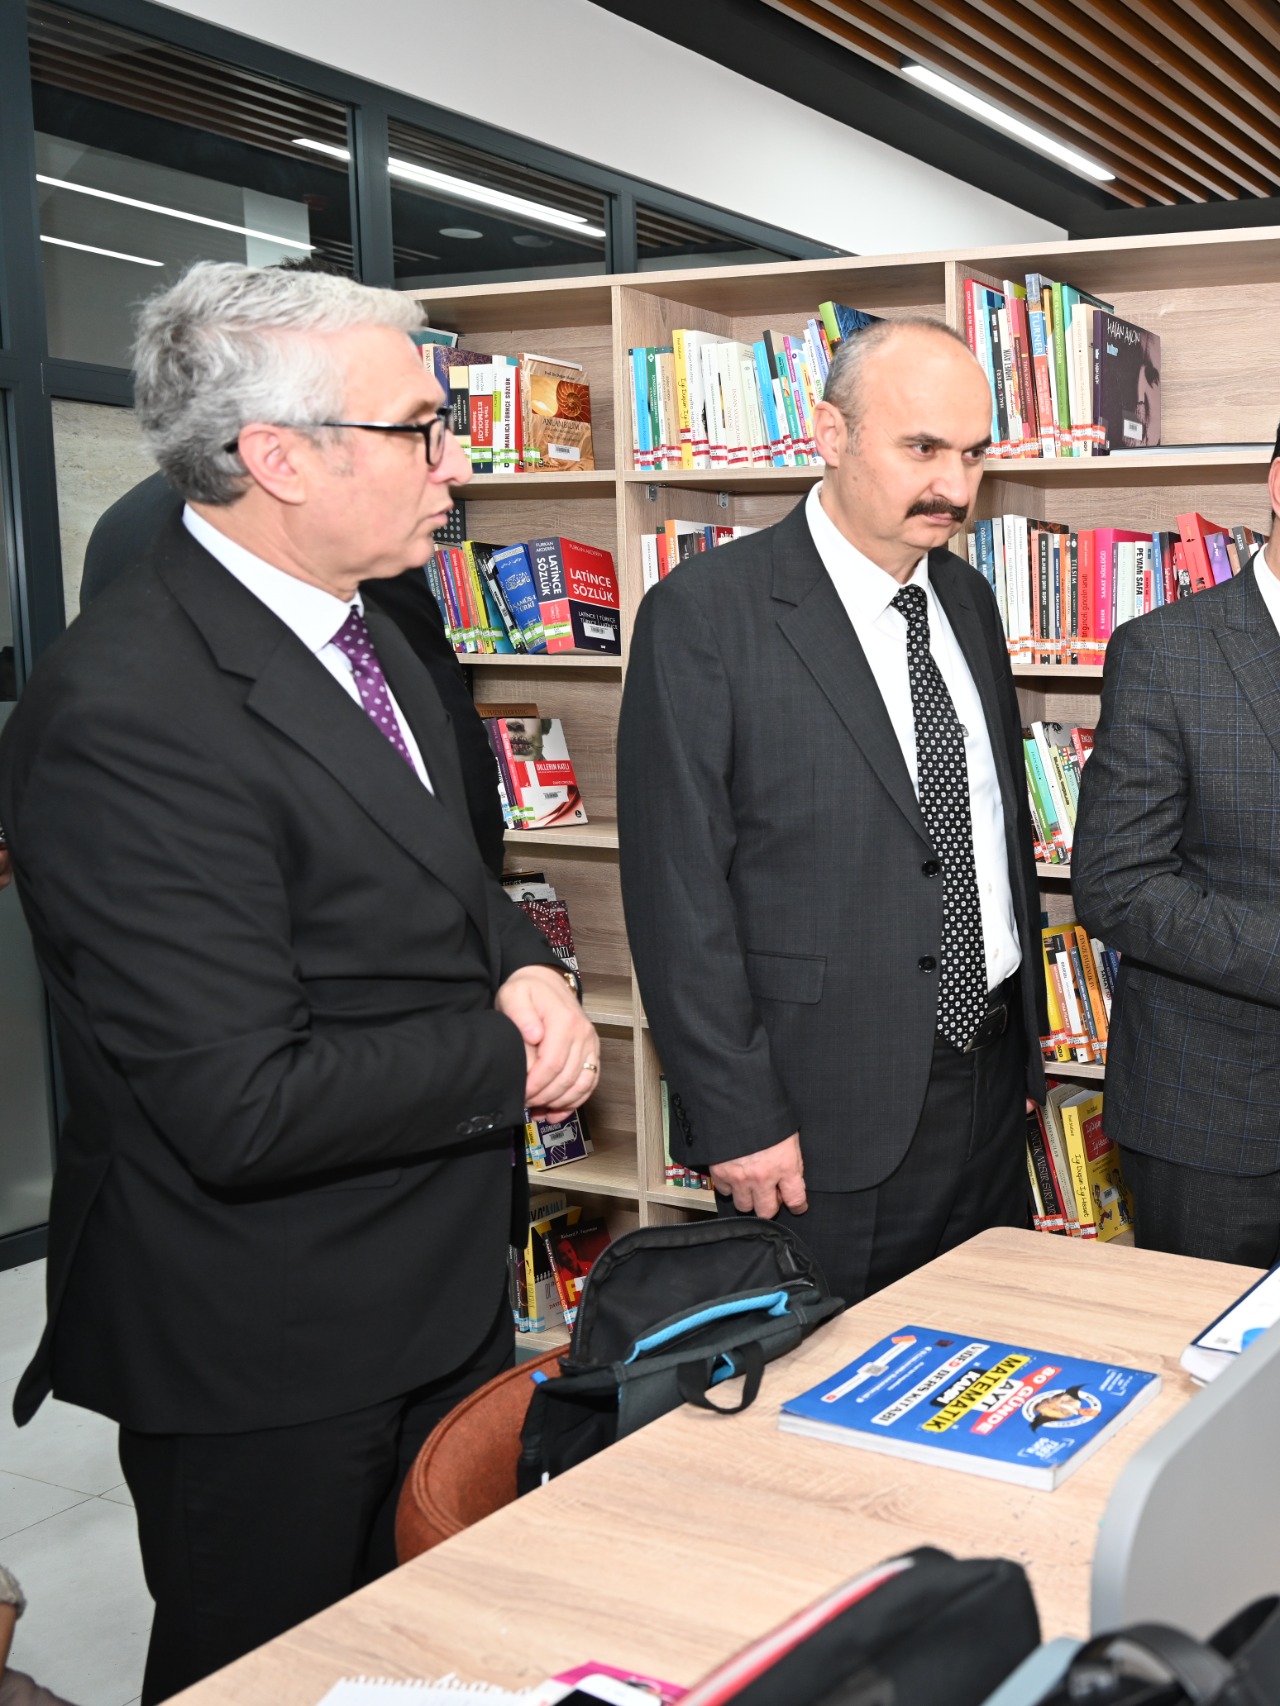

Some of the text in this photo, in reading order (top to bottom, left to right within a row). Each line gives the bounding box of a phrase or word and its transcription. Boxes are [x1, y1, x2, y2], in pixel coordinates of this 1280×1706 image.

[1032, 313, 1043, 355] TURNER
[536, 557, 551, 596] SÖZLÜK
[548, 555, 562, 594] LATİNCE
[570, 568, 612, 588] LATİNCE
[573, 583, 614, 602] SÖZLÜK
[579, 611, 596, 620] LATİNCE
[536, 763, 556, 771] DİLLERİN
[1079, 935, 1088, 954] CENAZE
[1030, 1128, 1040, 1155] ANTİK
[1037, 1155, 1048, 1182] MISIR
[1075, 1166, 1084, 1185] Düşün
[1082, 1197, 1090, 1217] Hisset
[914, 1368, 952, 1392] DERS
[924, 1355, 1021, 1430] MATEMATİK
[934, 1370, 984, 1402] KAMPI
[979, 1380, 1015, 1410] AYT
[878, 1392, 924, 1422] KİTABI
[975, 1366, 1058, 1434] 80 GÜNDE
